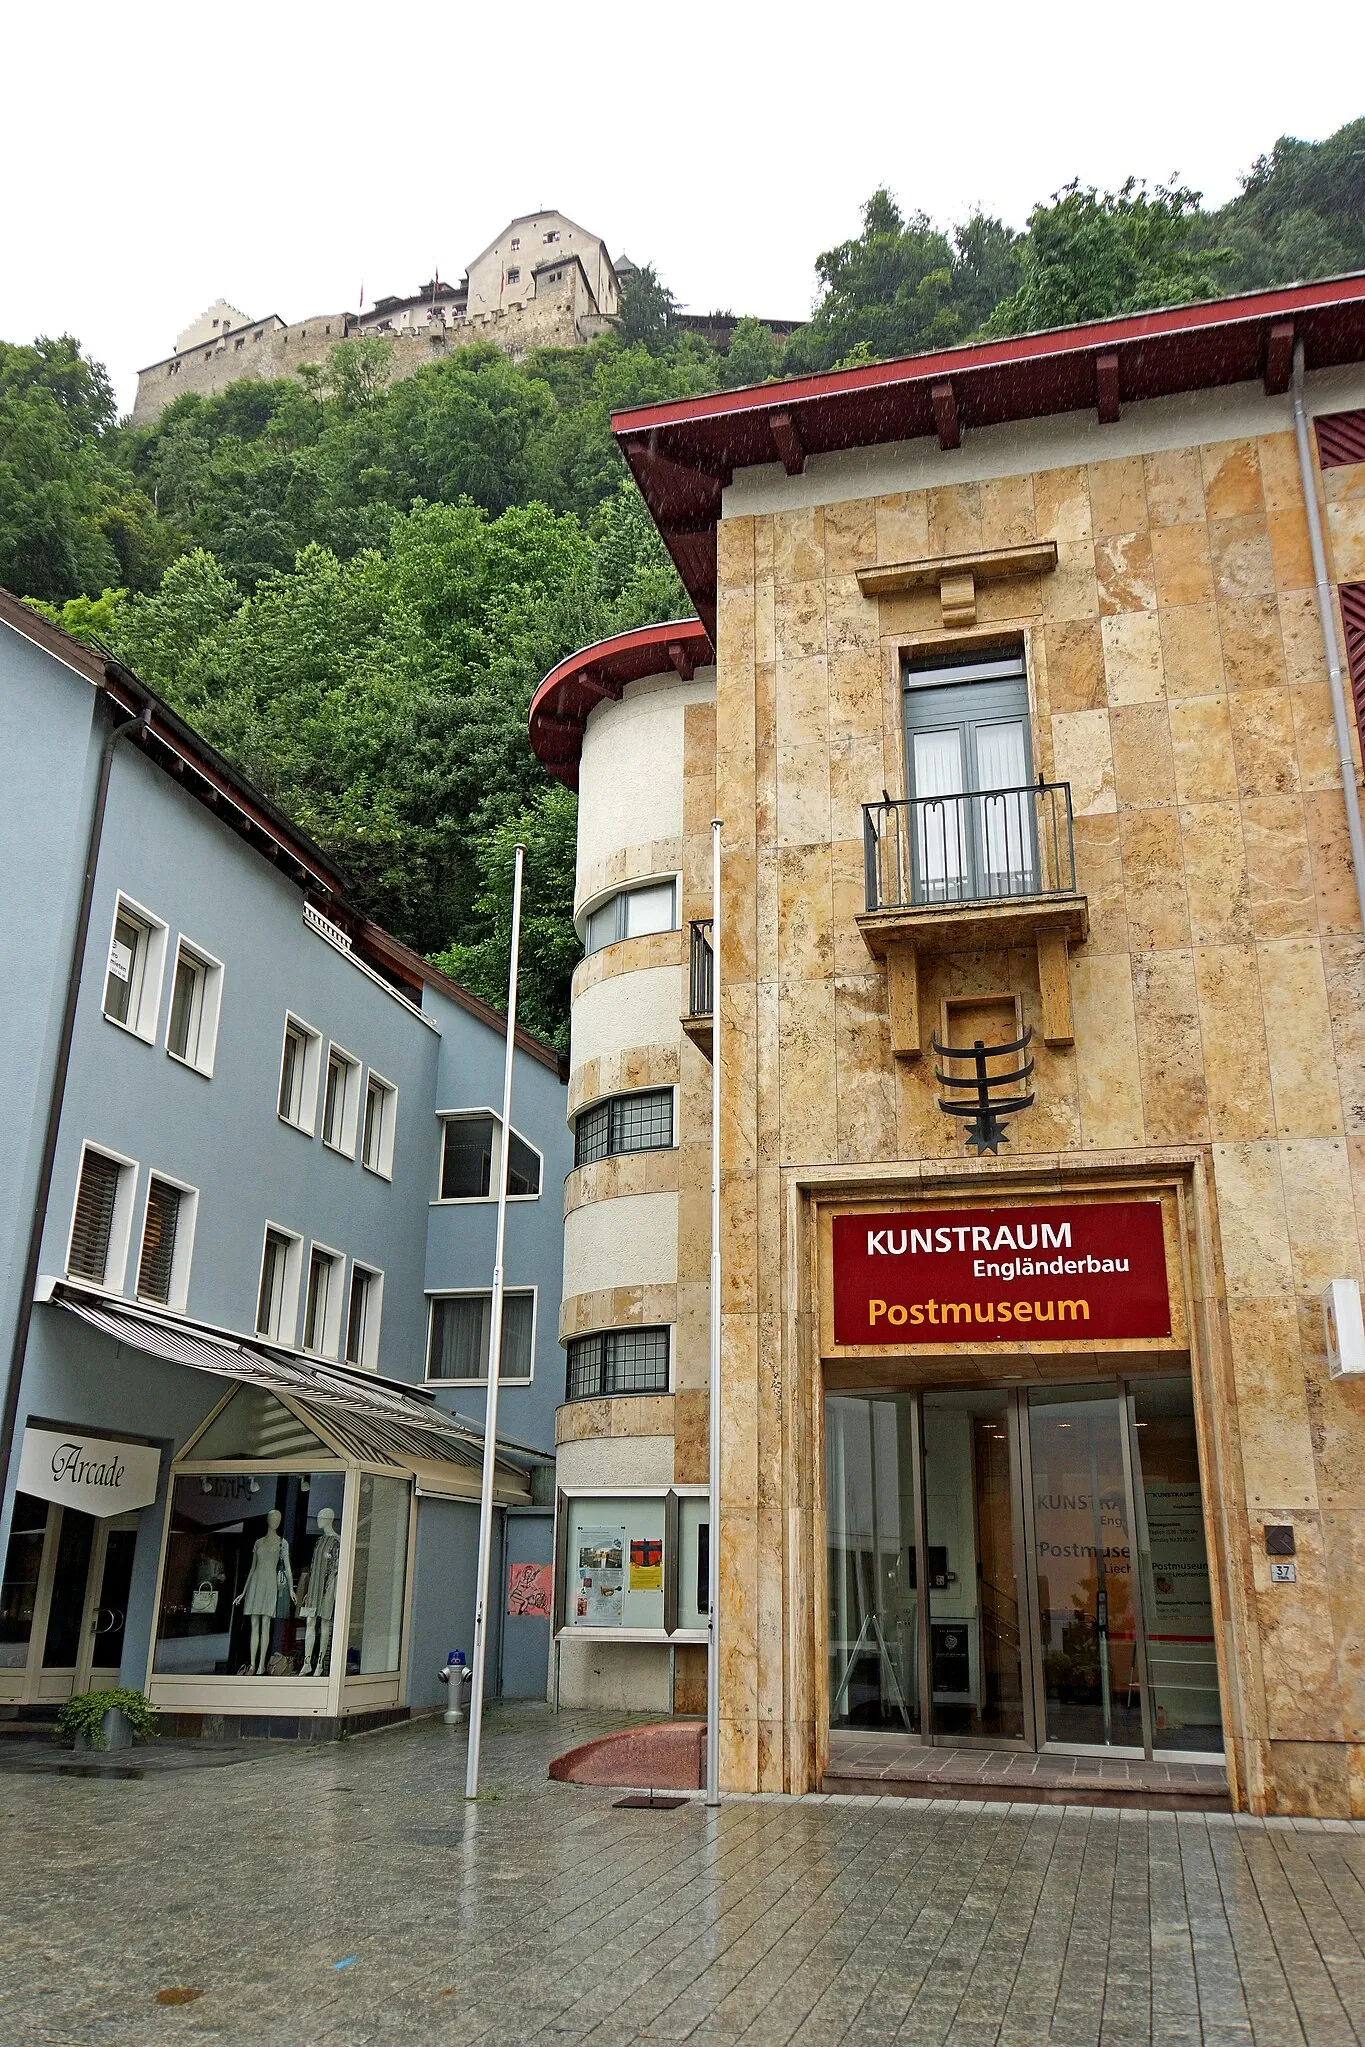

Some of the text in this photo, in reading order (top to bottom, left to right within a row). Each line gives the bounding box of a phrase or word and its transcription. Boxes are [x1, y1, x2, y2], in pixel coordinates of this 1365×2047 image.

[867, 1222, 1072, 1255] KUNSTRAUM
[973, 1255, 1130, 1281] Engländerbau
[869, 1298, 1090, 1326] Postmuseum
[51, 1442, 125, 1488] Arcade
[1276, 1565, 1290, 1576] 37
